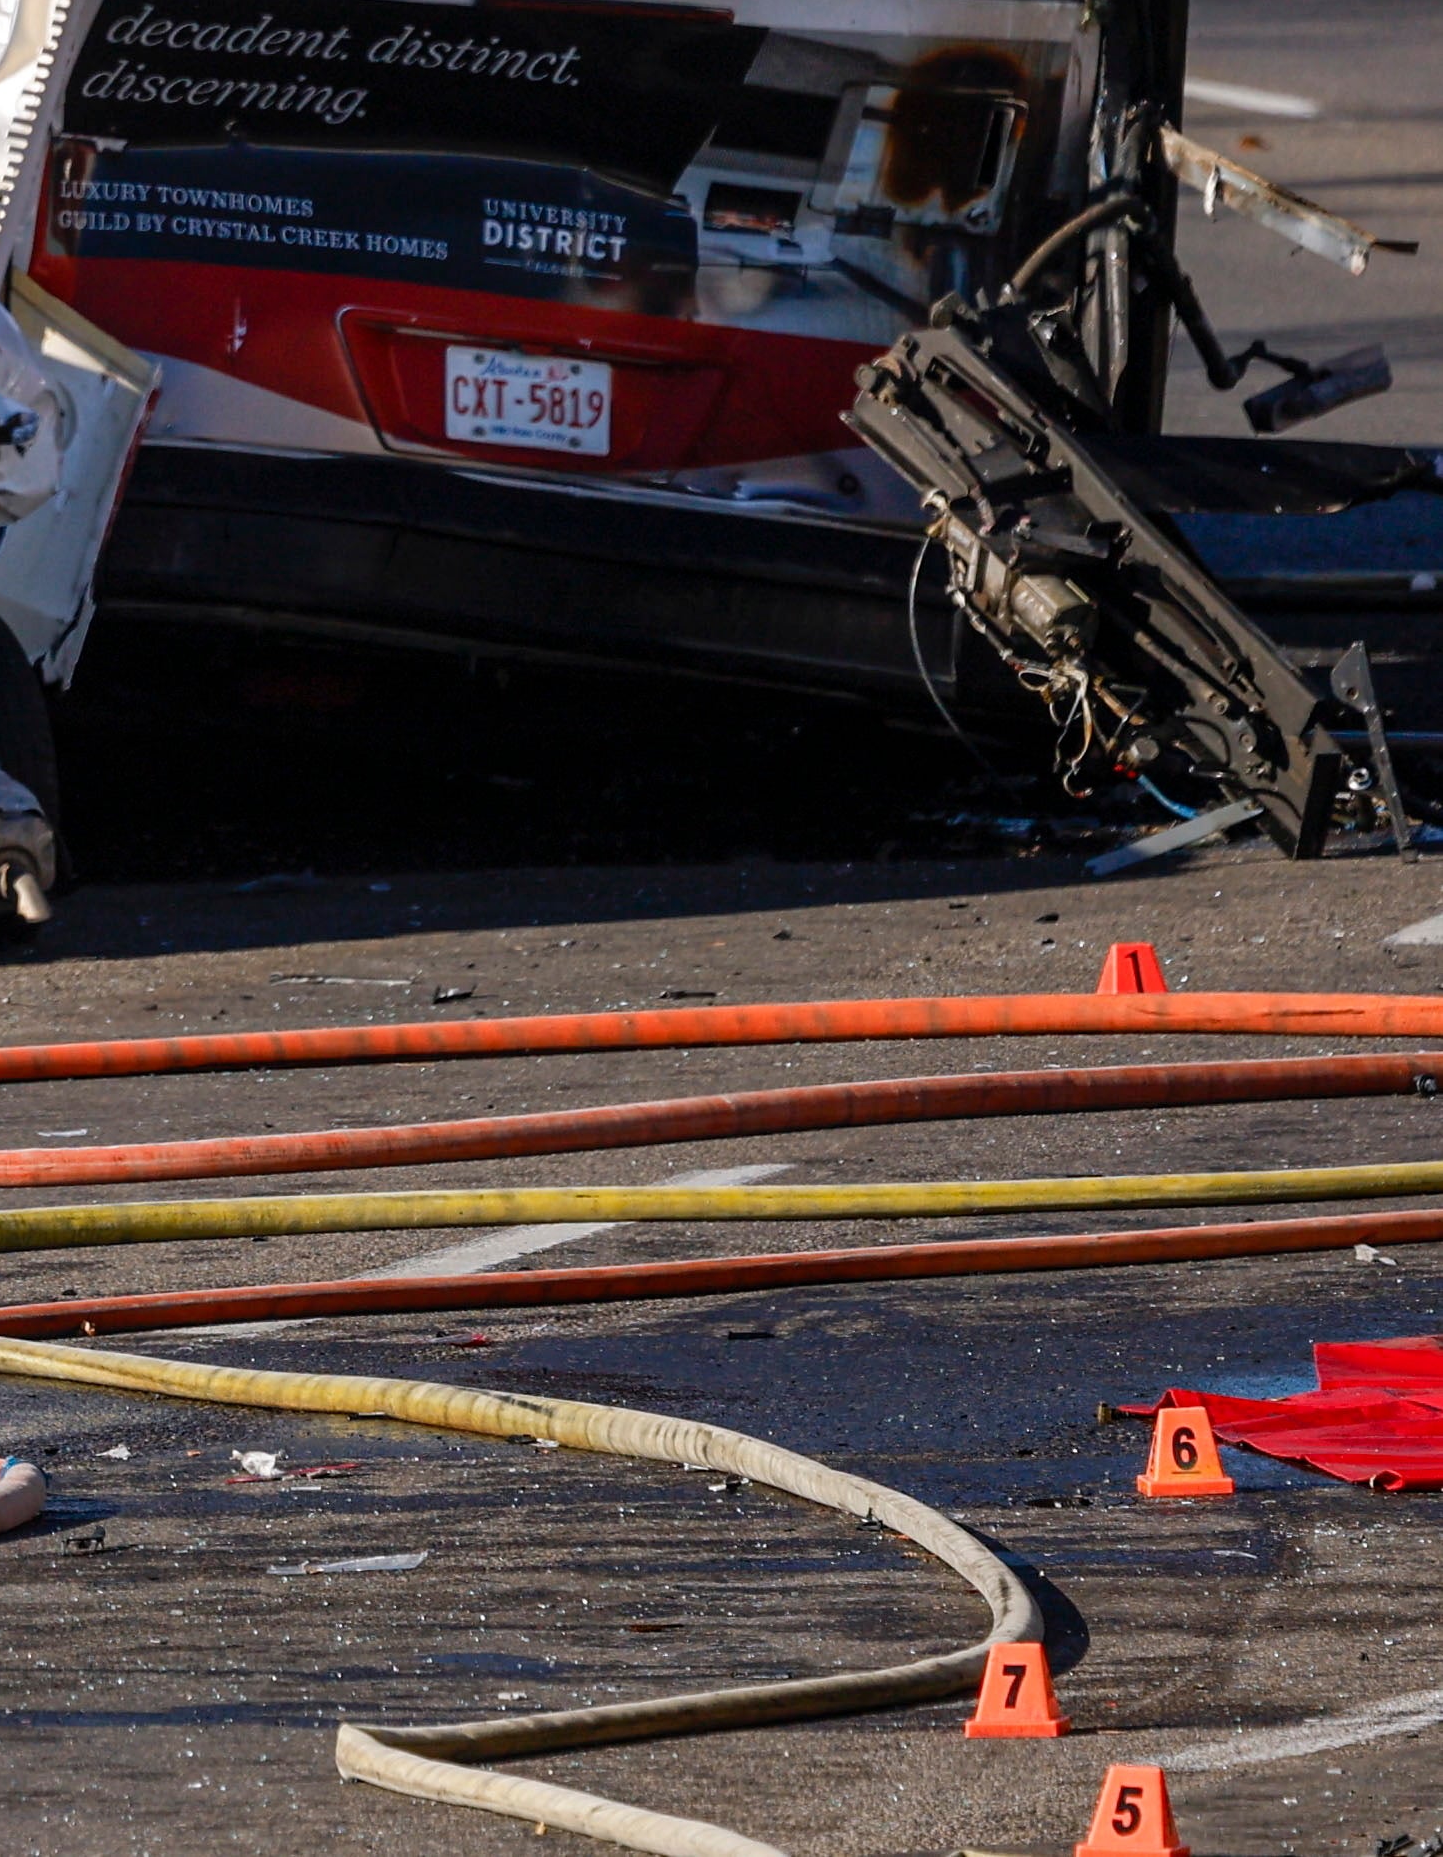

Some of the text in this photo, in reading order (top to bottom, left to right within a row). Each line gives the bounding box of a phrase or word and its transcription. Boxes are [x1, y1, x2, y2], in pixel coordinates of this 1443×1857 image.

[105, 5, 579, 86] decadent. distinct.
[81, 60, 367, 124] discerning.
[59, 180, 314, 218] LUXURY TOWNHOMES
[482, 198, 627, 233] UNIVERSITY
[137, 214, 166, 234] BY
[171, 216, 276, 242] CRYSTAL
[279, 226, 361, 250] CREEK
[366, 234, 449, 261] HOMES
[482, 219, 627, 262] DISTRICT
[453, 375, 604, 430] CXT-5819
[1172, 1427, 1198, 1470] 6
[1001, 1665, 1027, 1709] 7
[1112, 1786, 1143, 1836] 5
